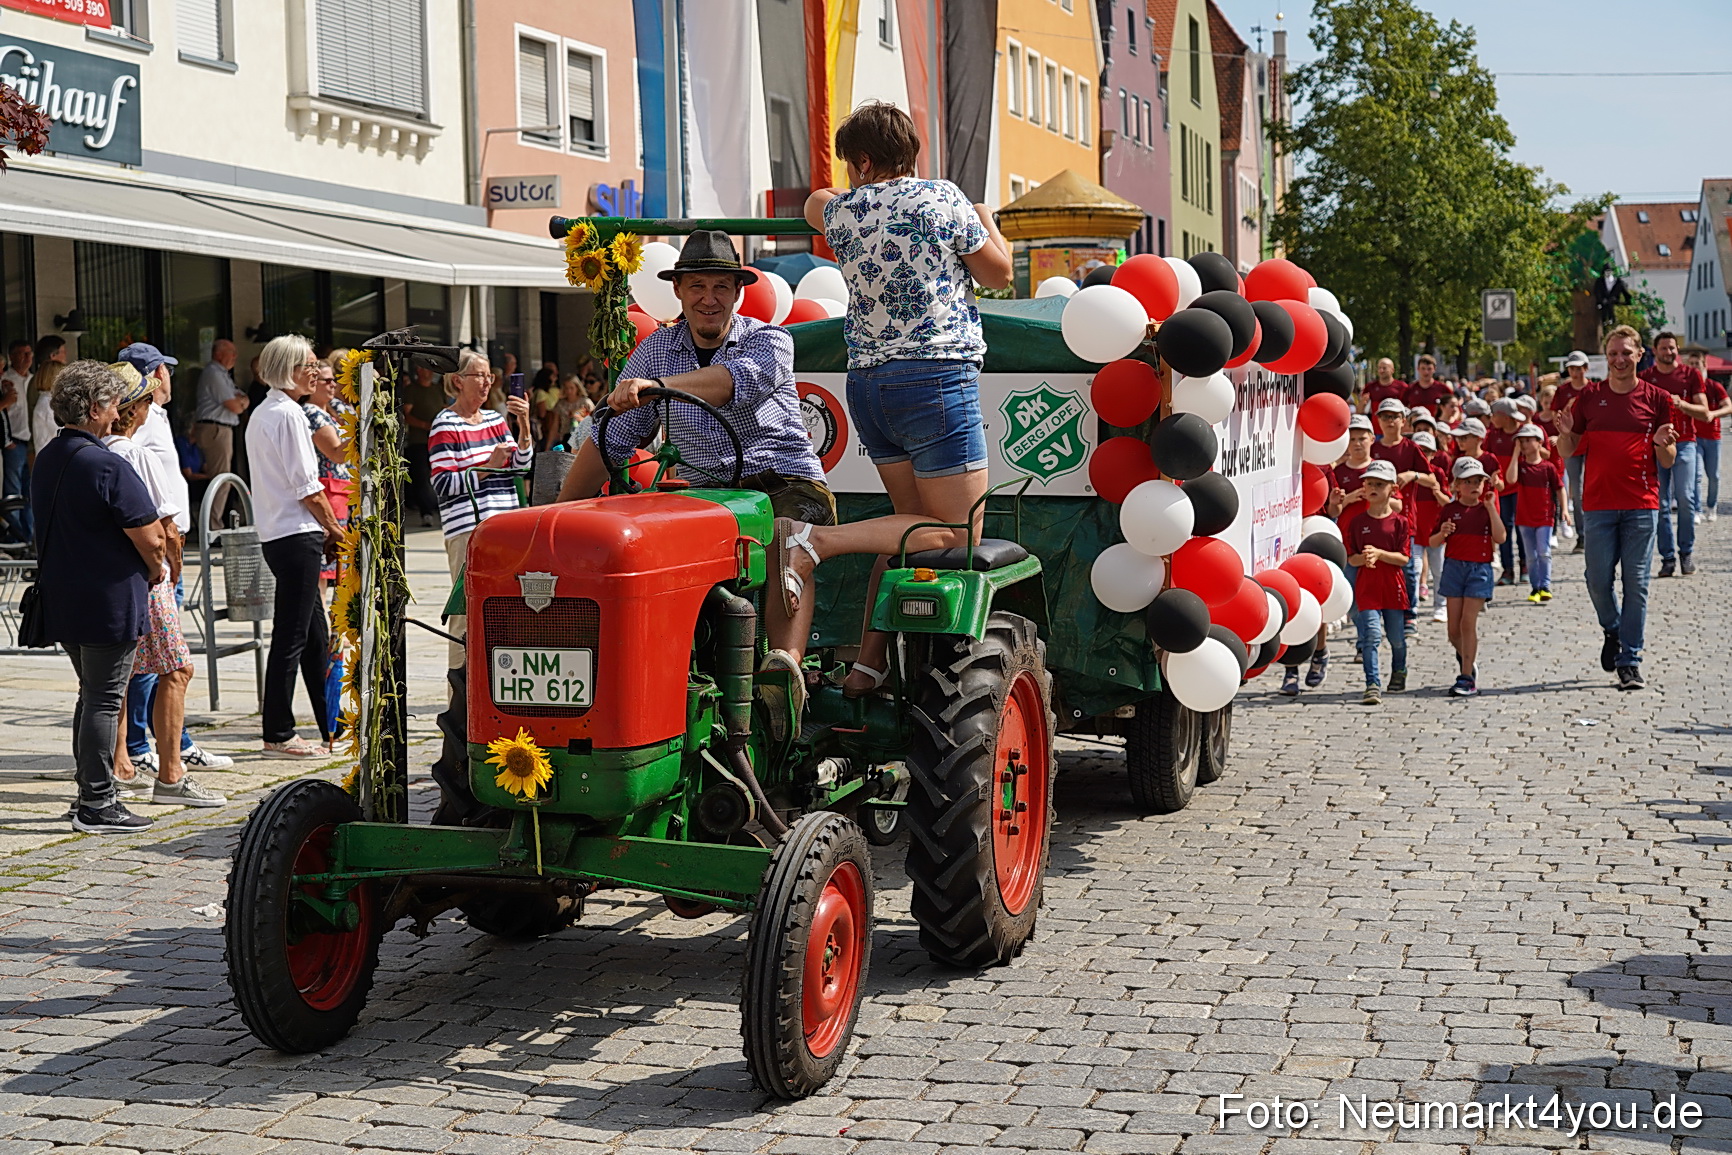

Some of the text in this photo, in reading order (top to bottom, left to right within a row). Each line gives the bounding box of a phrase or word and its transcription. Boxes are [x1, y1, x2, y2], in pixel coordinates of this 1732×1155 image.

[85, 0, 105, 17] 390
[489, 181, 555, 203] sutor.
[1014, 393, 1051, 429] DJK
[1237, 371, 1255, 419] only
[1012, 428, 1046, 457] BERG
[1050, 404, 1078, 427] OPF.
[1037, 432, 1074, 471] SV
[1221, 429, 1276, 477] but we like it!
[522, 652, 560, 676] NM
[500, 677, 585, 702] HR 612
